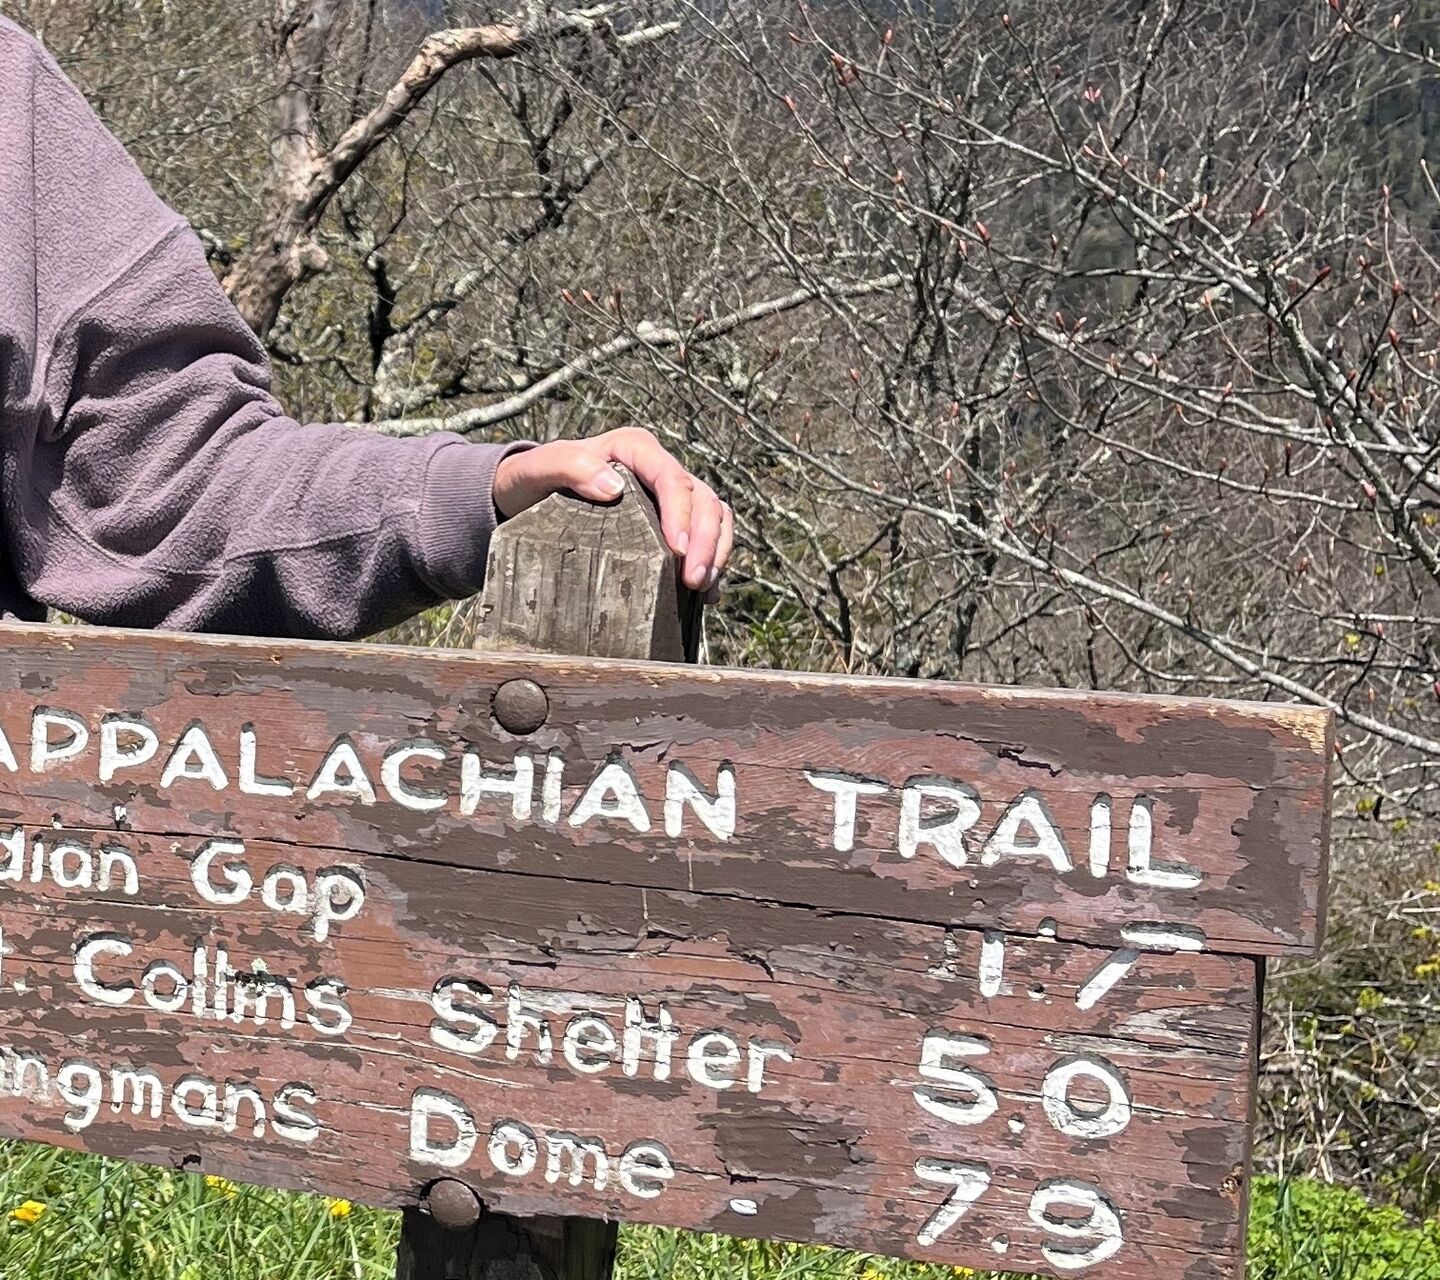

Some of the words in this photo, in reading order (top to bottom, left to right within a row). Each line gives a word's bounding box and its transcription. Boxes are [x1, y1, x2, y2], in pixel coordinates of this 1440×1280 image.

[802, 770, 1204, 889] TRAIL
[190, 838, 366, 942] Gap
[976, 920, 1207, 1011] 1.7
[72, 932, 355, 1037] Collins
[429, 975, 795, 1093] Shelter
[912, 1030, 1132, 1139] 5.0
[409, 1086, 677, 1199] Dome
[914, 1157, 1125, 1269] 7.9
